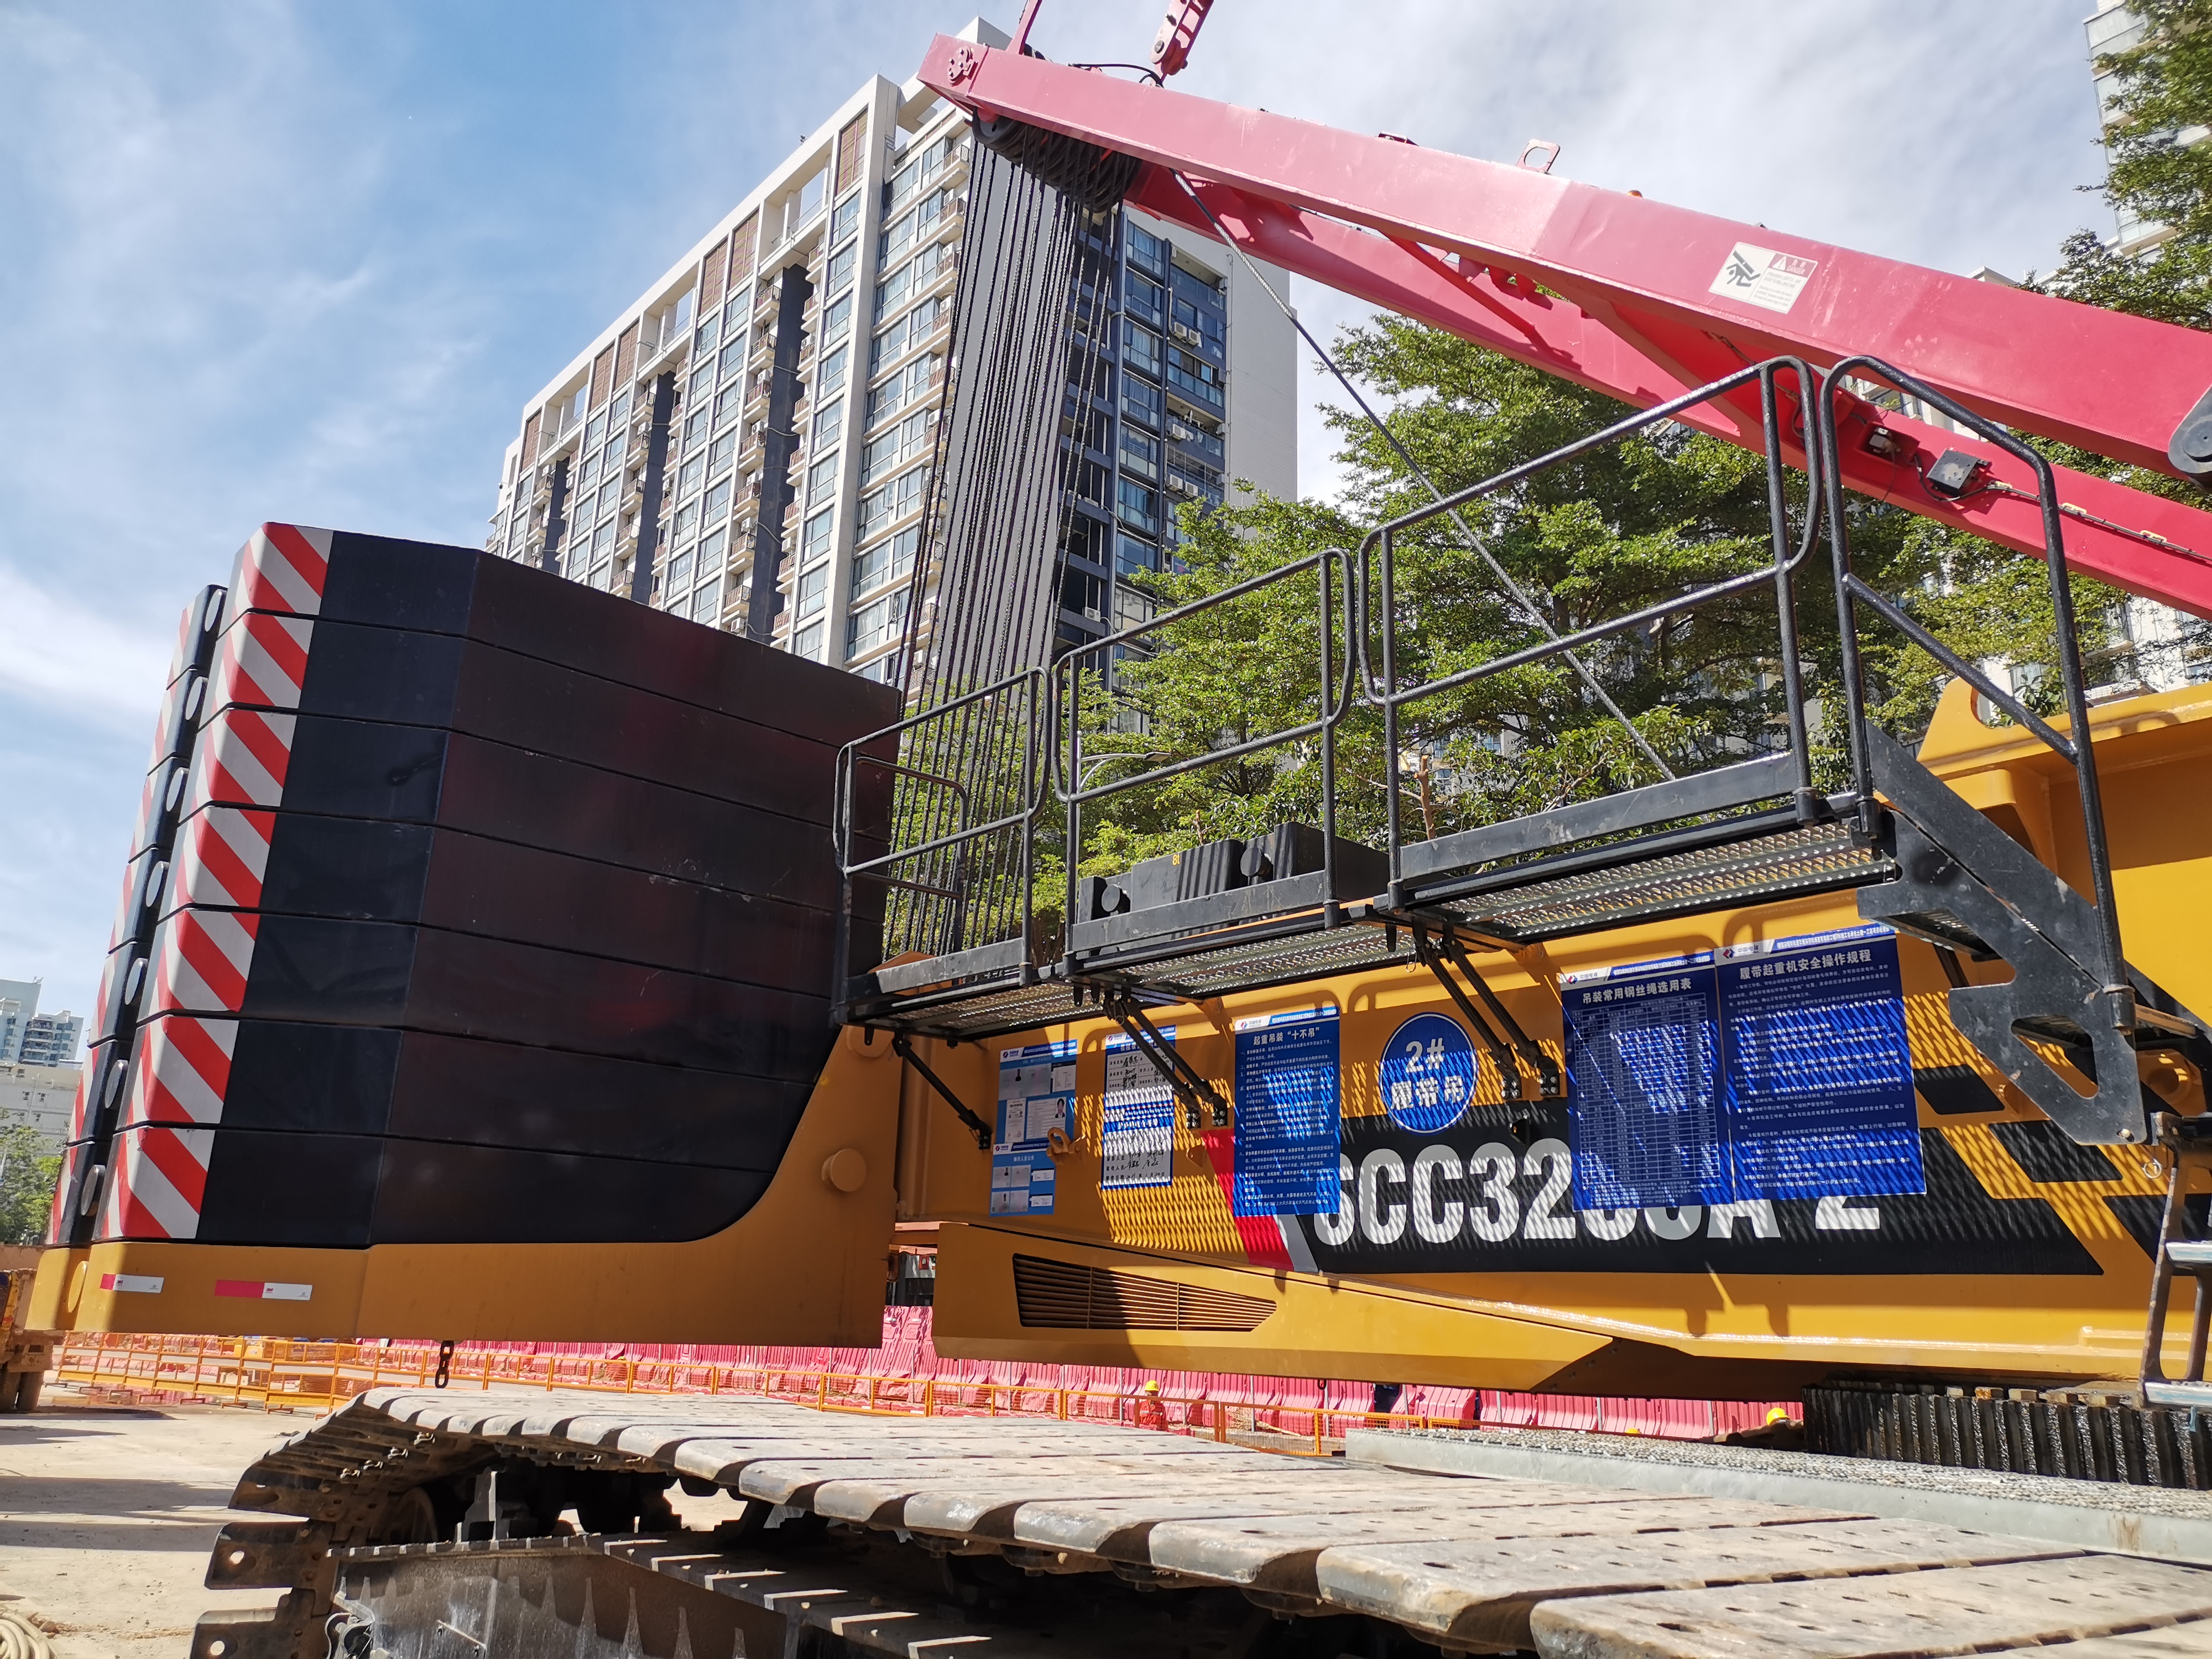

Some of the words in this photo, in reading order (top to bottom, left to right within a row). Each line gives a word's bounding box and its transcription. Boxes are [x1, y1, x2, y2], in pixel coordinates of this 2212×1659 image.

[1739, 949, 1872, 980] 履带起重机安全操作规程
[1583, 978, 1692, 1004] 吊装常用钢丝绳选用表
[1406, 1037, 1444, 1073] 2#
[1391, 1075, 1465, 1111] 履带吊
